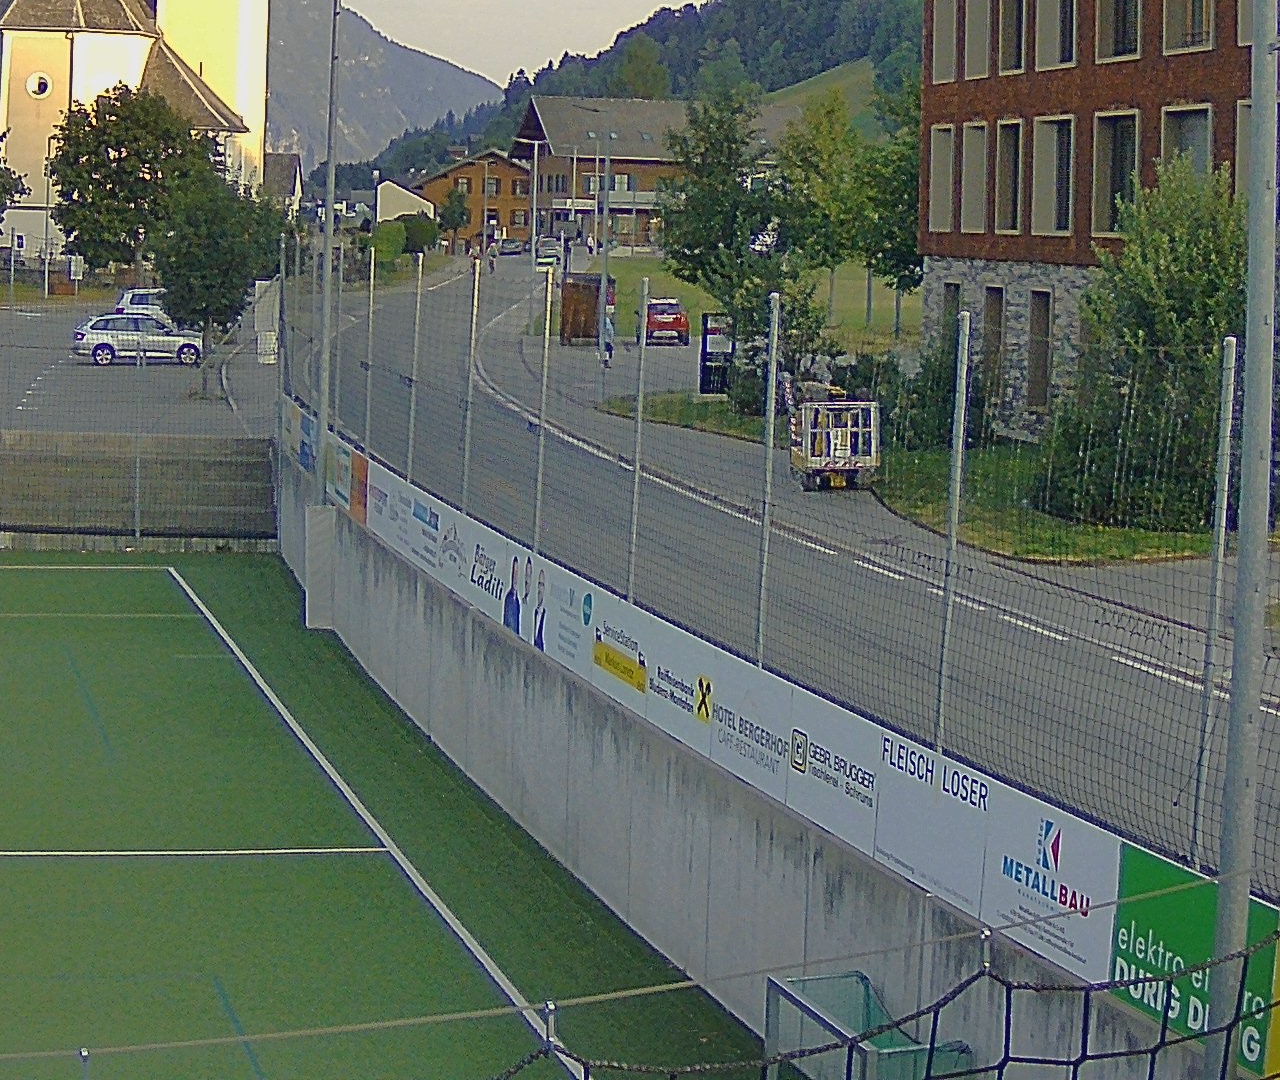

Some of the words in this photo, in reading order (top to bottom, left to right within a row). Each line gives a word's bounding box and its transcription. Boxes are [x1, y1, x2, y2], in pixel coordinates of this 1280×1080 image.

[712, 702, 737, 731] HOTEL
[738, 715, 790, 758] BERGERHOF
[808, 742, 832, 769] GEBR.
[881, 736, 935, 786] FLEISCH
[941, 764, 989, 812] LOSER
[1001, 854, 1091, 918] METALLBAU
[1117, 920, 1184, 976] elektro
